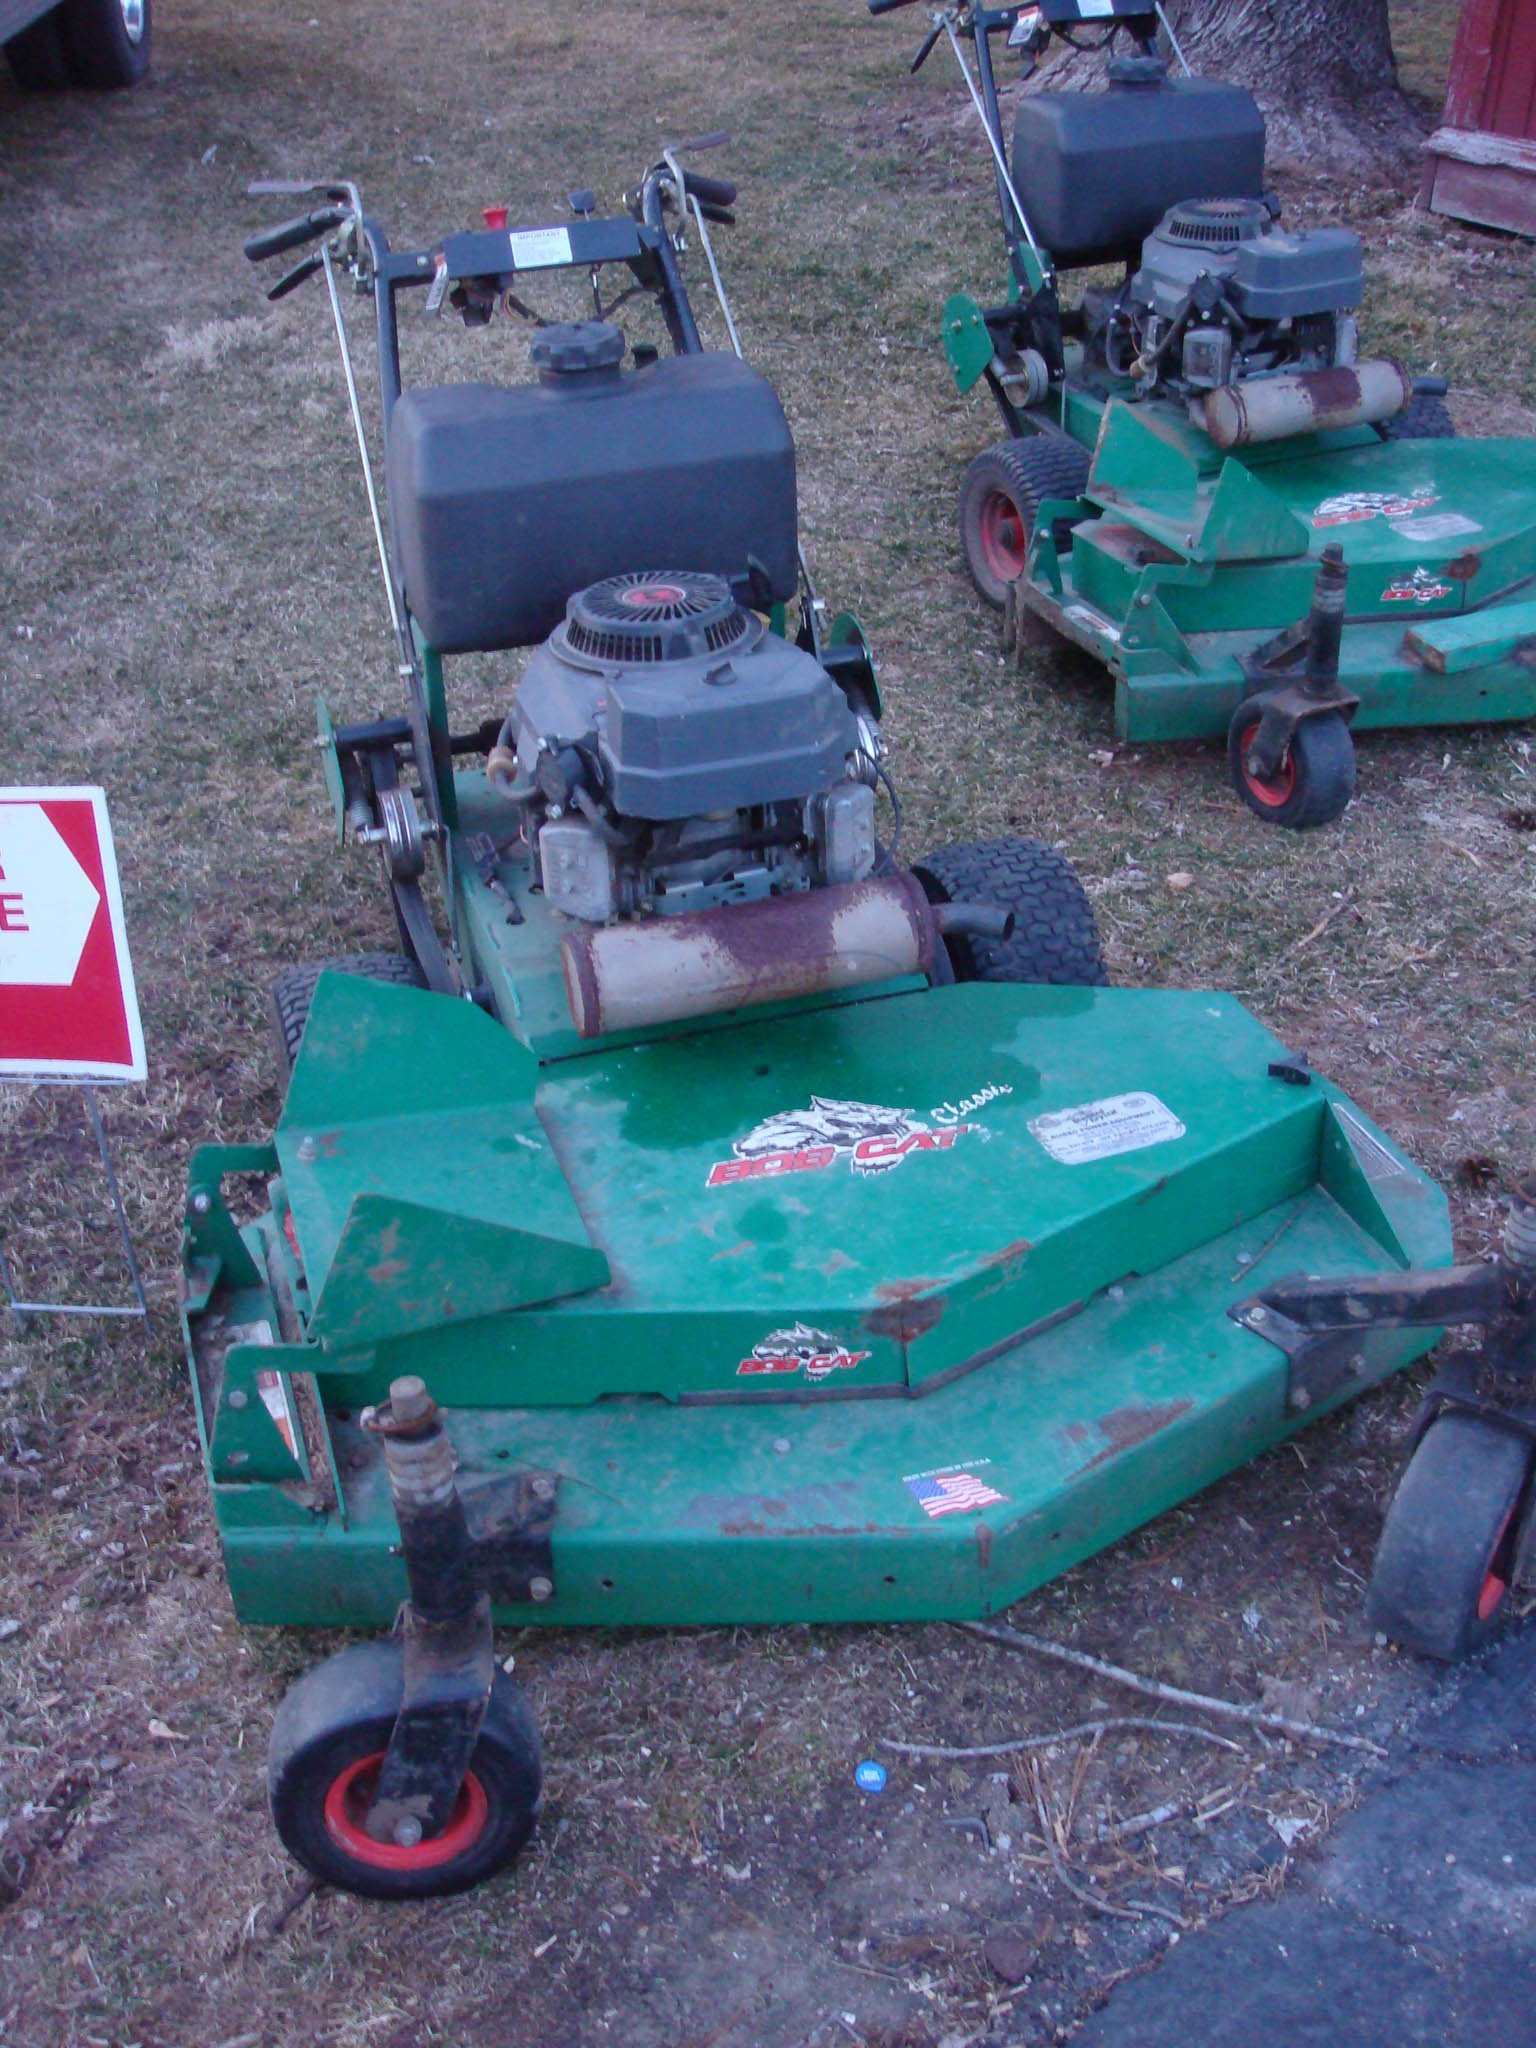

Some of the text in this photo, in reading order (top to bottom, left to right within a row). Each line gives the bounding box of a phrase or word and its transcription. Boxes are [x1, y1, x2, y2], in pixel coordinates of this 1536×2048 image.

[705, 1123, 969, 1187] BOB CAT
[736, 1351, 872, 1375] BOB CAT
